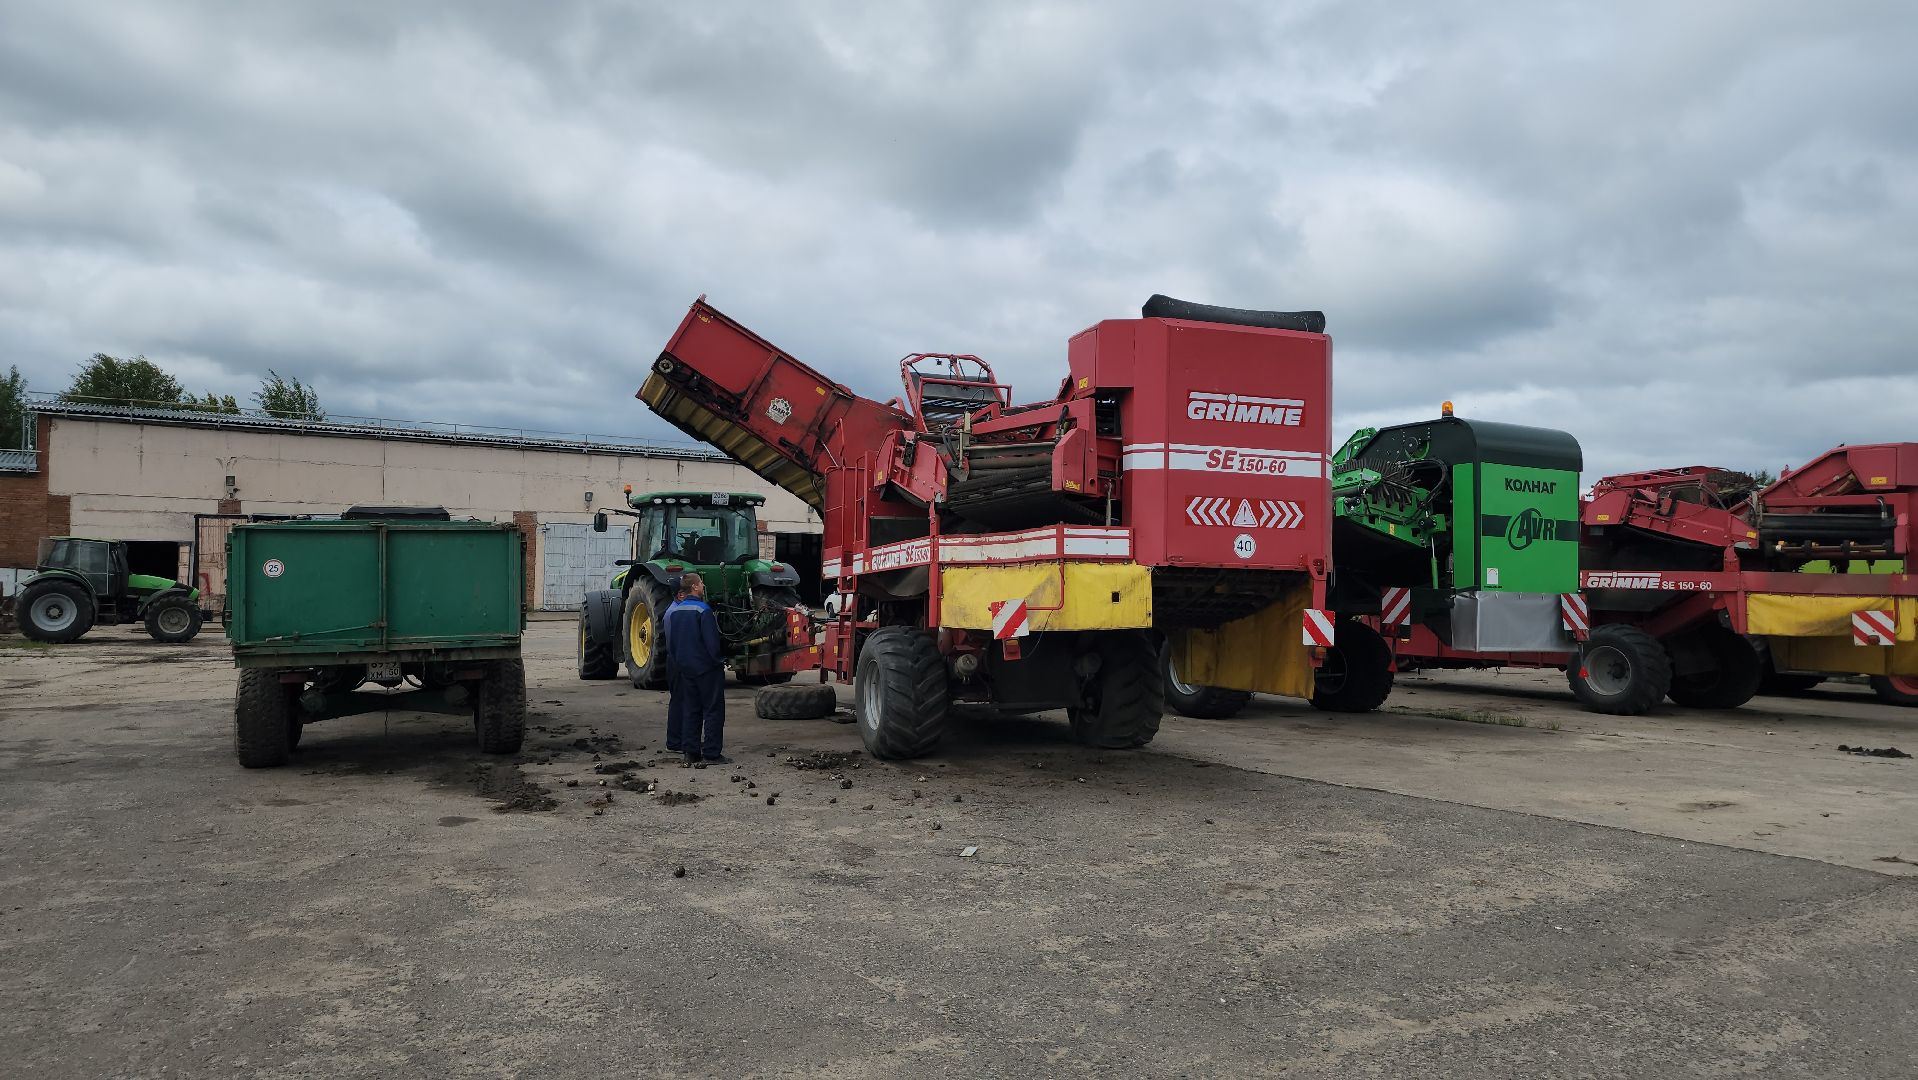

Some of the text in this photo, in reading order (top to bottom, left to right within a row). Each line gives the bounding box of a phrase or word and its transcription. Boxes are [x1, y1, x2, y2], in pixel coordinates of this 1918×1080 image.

[1187, 393, 1304, 426] GRIMME
[1206, 449, 1287, 474] SE 150-60
[1504, 477, 1557, 495] КОЛНАГ
[1510, 508, 1556, 548] AVR
[1236, 540, 1252, 552] 40
[268, 564, 279, 573] 25
[1661, 581, 1675, 590] SE
[1679, 581, 1712, 590] 150-60
